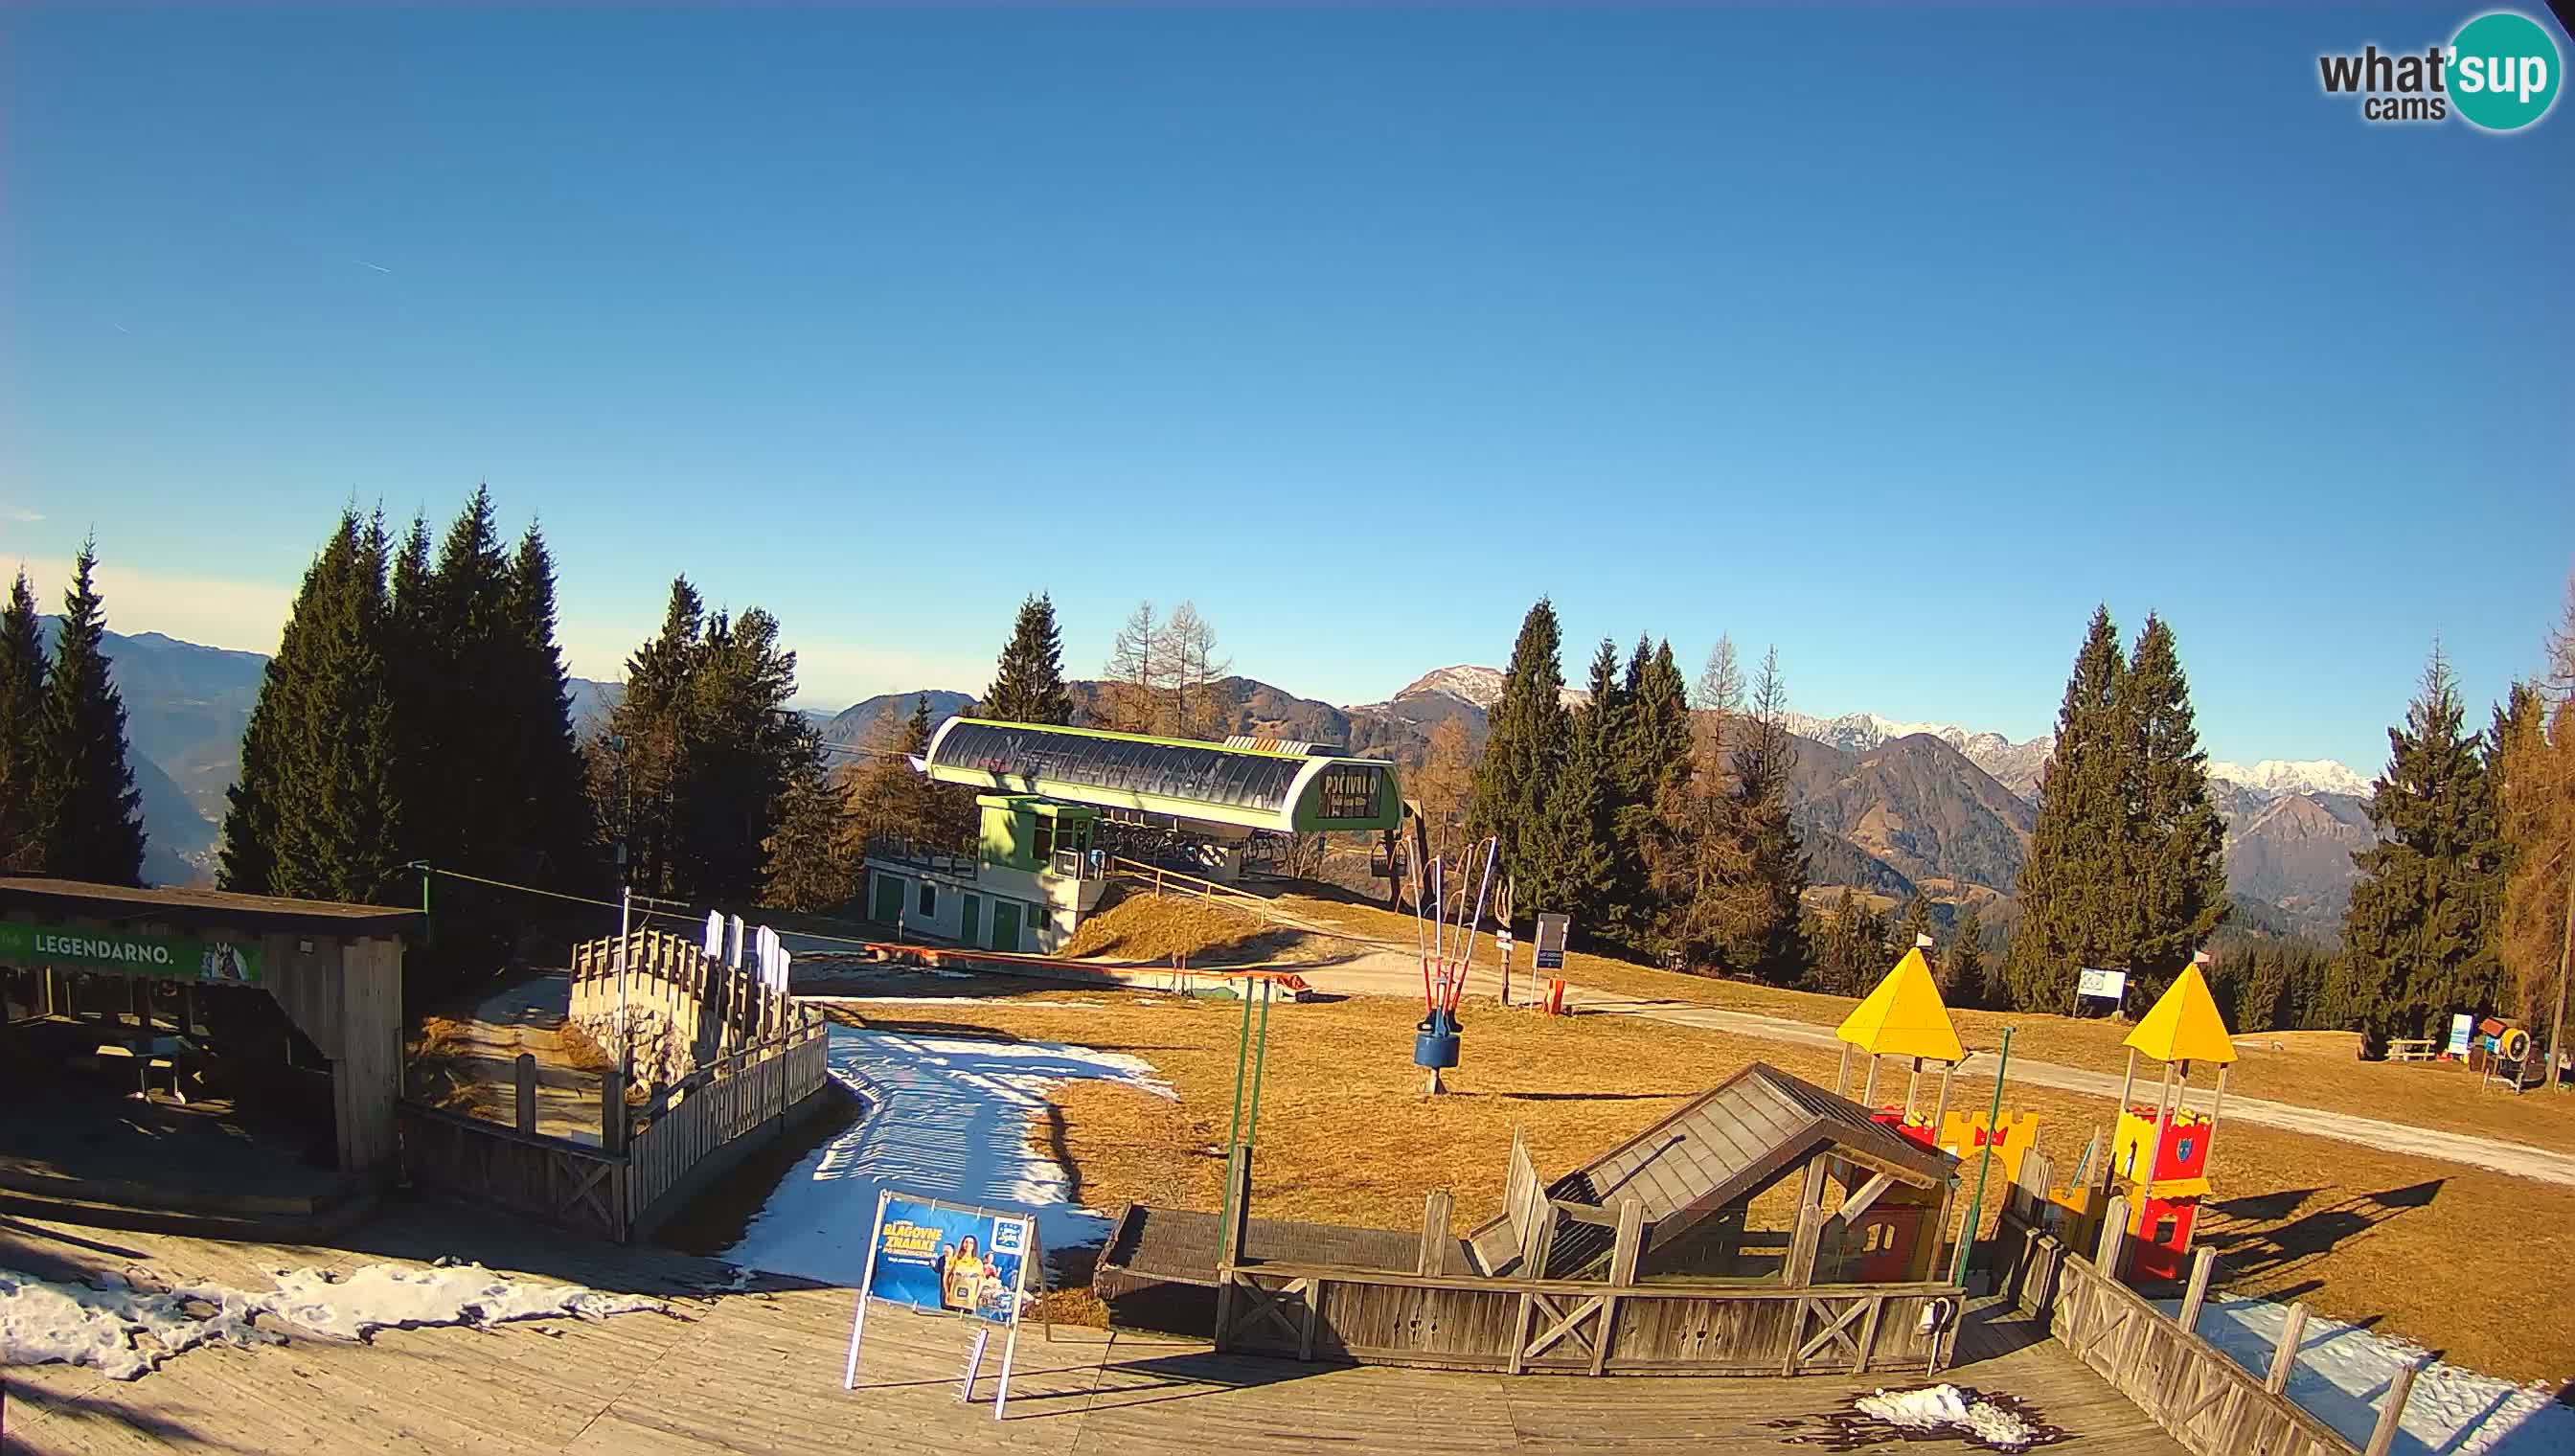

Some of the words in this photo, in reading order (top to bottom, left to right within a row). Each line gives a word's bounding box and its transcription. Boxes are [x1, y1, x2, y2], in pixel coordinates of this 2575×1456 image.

[34, 933, 174, 966] LEGENDARNO.
[882, 1223, 944, 1241] BLAGOVNE
[885, 1236, 936, 1252] ZNAMKE
